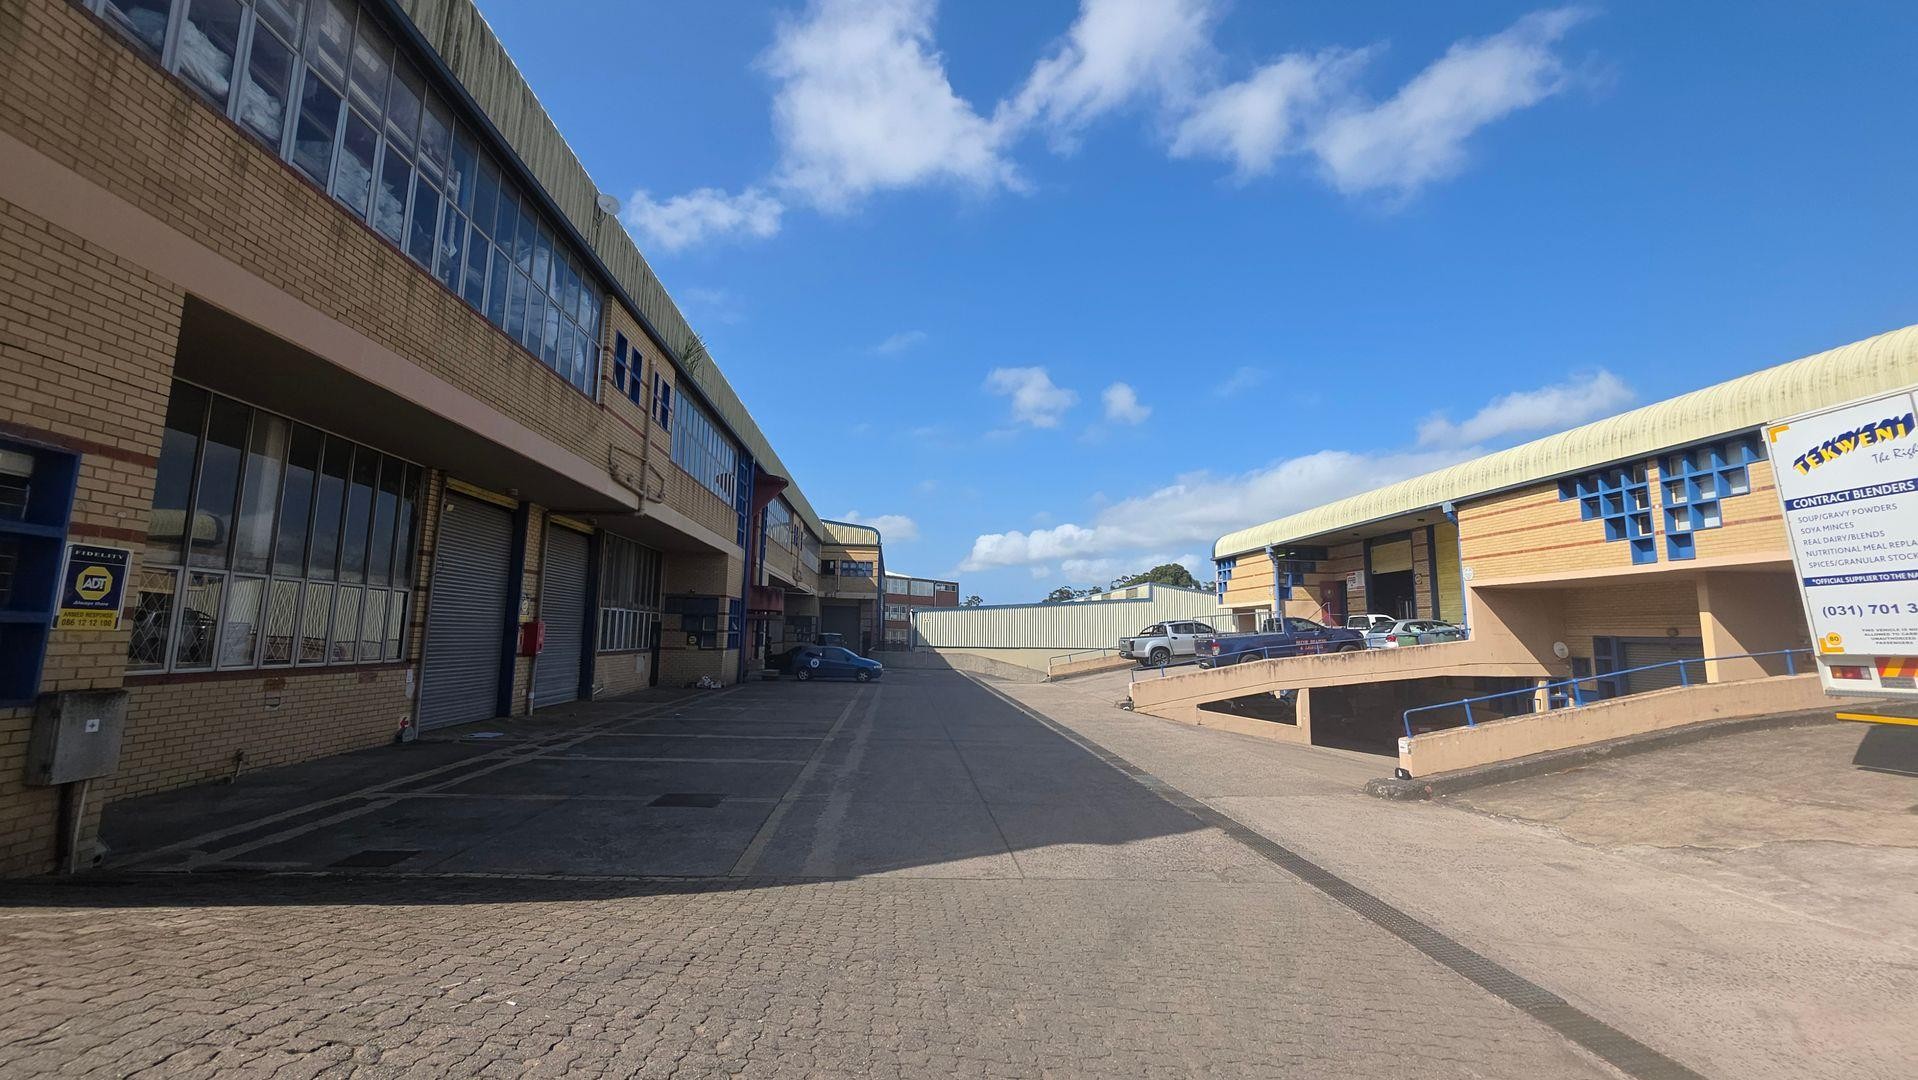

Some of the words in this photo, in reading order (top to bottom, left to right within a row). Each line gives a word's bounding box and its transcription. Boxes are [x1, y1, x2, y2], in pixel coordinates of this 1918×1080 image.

[1793, 413, 1915, 476] TEKWENI
[1872, 452, 1890, 464] The
[1793, 491, 1851, 509] CONTRACT
[1853, 481, 1915, 499] BLENDERS
[1798, 511, 1850, 523] SOUP/GRAVY
[1852, 503, 1898, 515] POWDERS
[1800, 526, 1821, 534] SOYA
[1823, 522, 1855, 532] MINCES
[1803, 537, 1822, 546] REAL
[1823, 530, 1885, 544] DAIRY/BLENDS
[75, 550, 124, 560] FIDELITY
[1806, 544, 1861, 557] NUTRITIONAL
[1863, 542, 1888, 552] MEAL
[1808, 555, 1887, 568] SPICES/GRANULAR
[82, 577, 107, 590] ADT
[1845, 574, 1877, 583] SUPPLIER
[1878, 573, 1890, 581] TO
[1890, 572, 1907, 580] THE
[1822, 605, 1863, 619] (031)
[1868, 604, 1900, 615] 701
